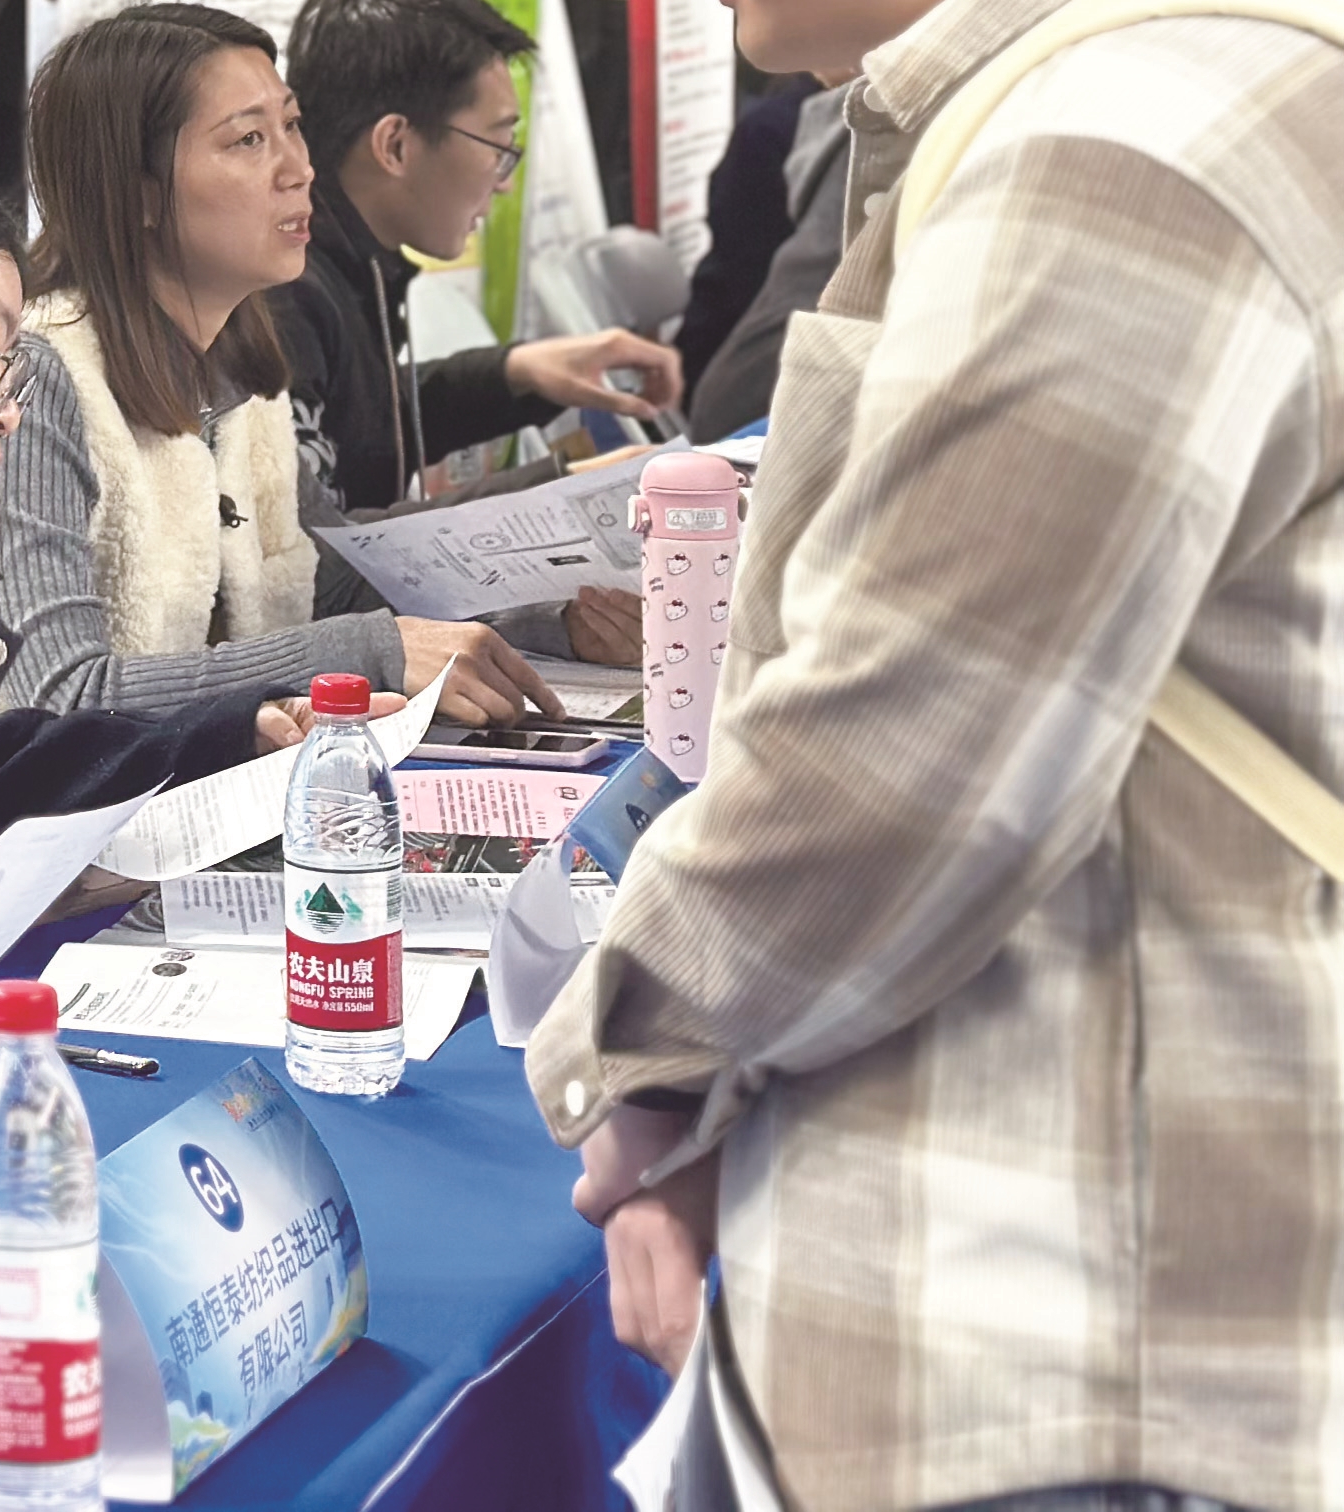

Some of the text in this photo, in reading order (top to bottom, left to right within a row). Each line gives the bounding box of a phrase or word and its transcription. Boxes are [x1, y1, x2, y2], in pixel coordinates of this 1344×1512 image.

[288, 951, 374, 984] 农夫山泉
[329, 986, 374, 999] SPRING
[190, 1158, 238, 1215] 64
[165, 1198, 343, 1369] 南通恒泰纺织品进出口
[238, 1300, 309, 1397] 有限公司
